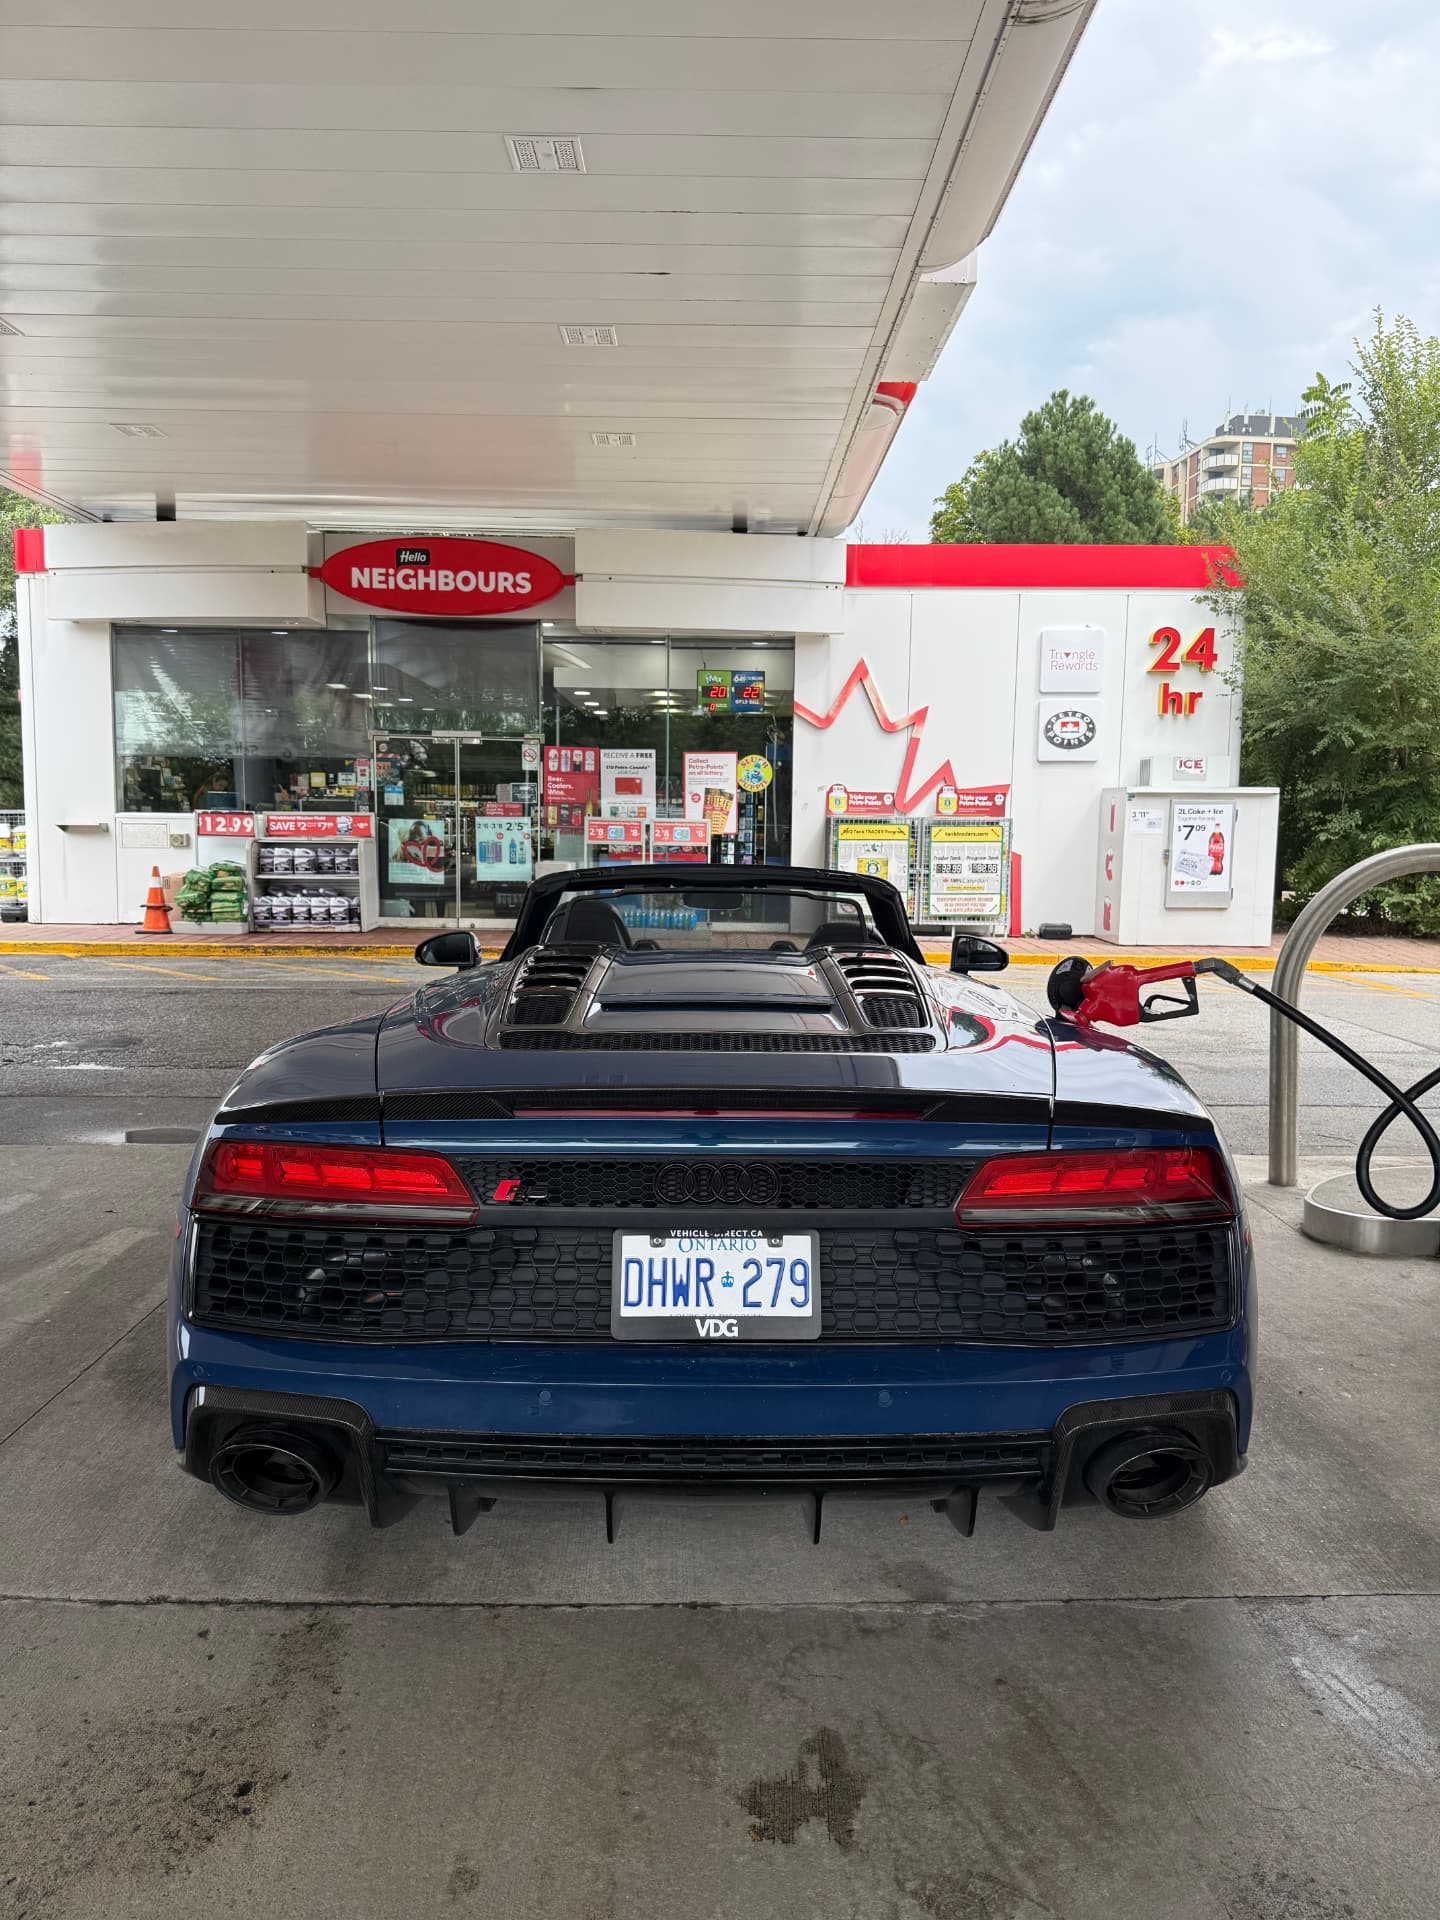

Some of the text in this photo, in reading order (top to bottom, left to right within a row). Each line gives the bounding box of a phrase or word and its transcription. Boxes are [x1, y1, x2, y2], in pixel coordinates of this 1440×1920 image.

[400, 550, 427, 563] Hello
[1146, 627, 1218, 672] 24
[1050, 660, 1098, 671] Rewards
[710, 686, 727, 698] 20
[743, 687, 760, 698] 22
[1158, 683, 1203, 716] hr
[1051, 711, 1091, 723] PETRO
[1047, 731, 1093, 746] POINTS
[1178, 759, 1203, 769] ICE
[270, 822, 296, 831] SAVE
[678, 1238, 757, 1253] ONTARIO
[623, 1257, 810, 1308] DHWR 279
[694, 1319, 739, 1337] VDG
